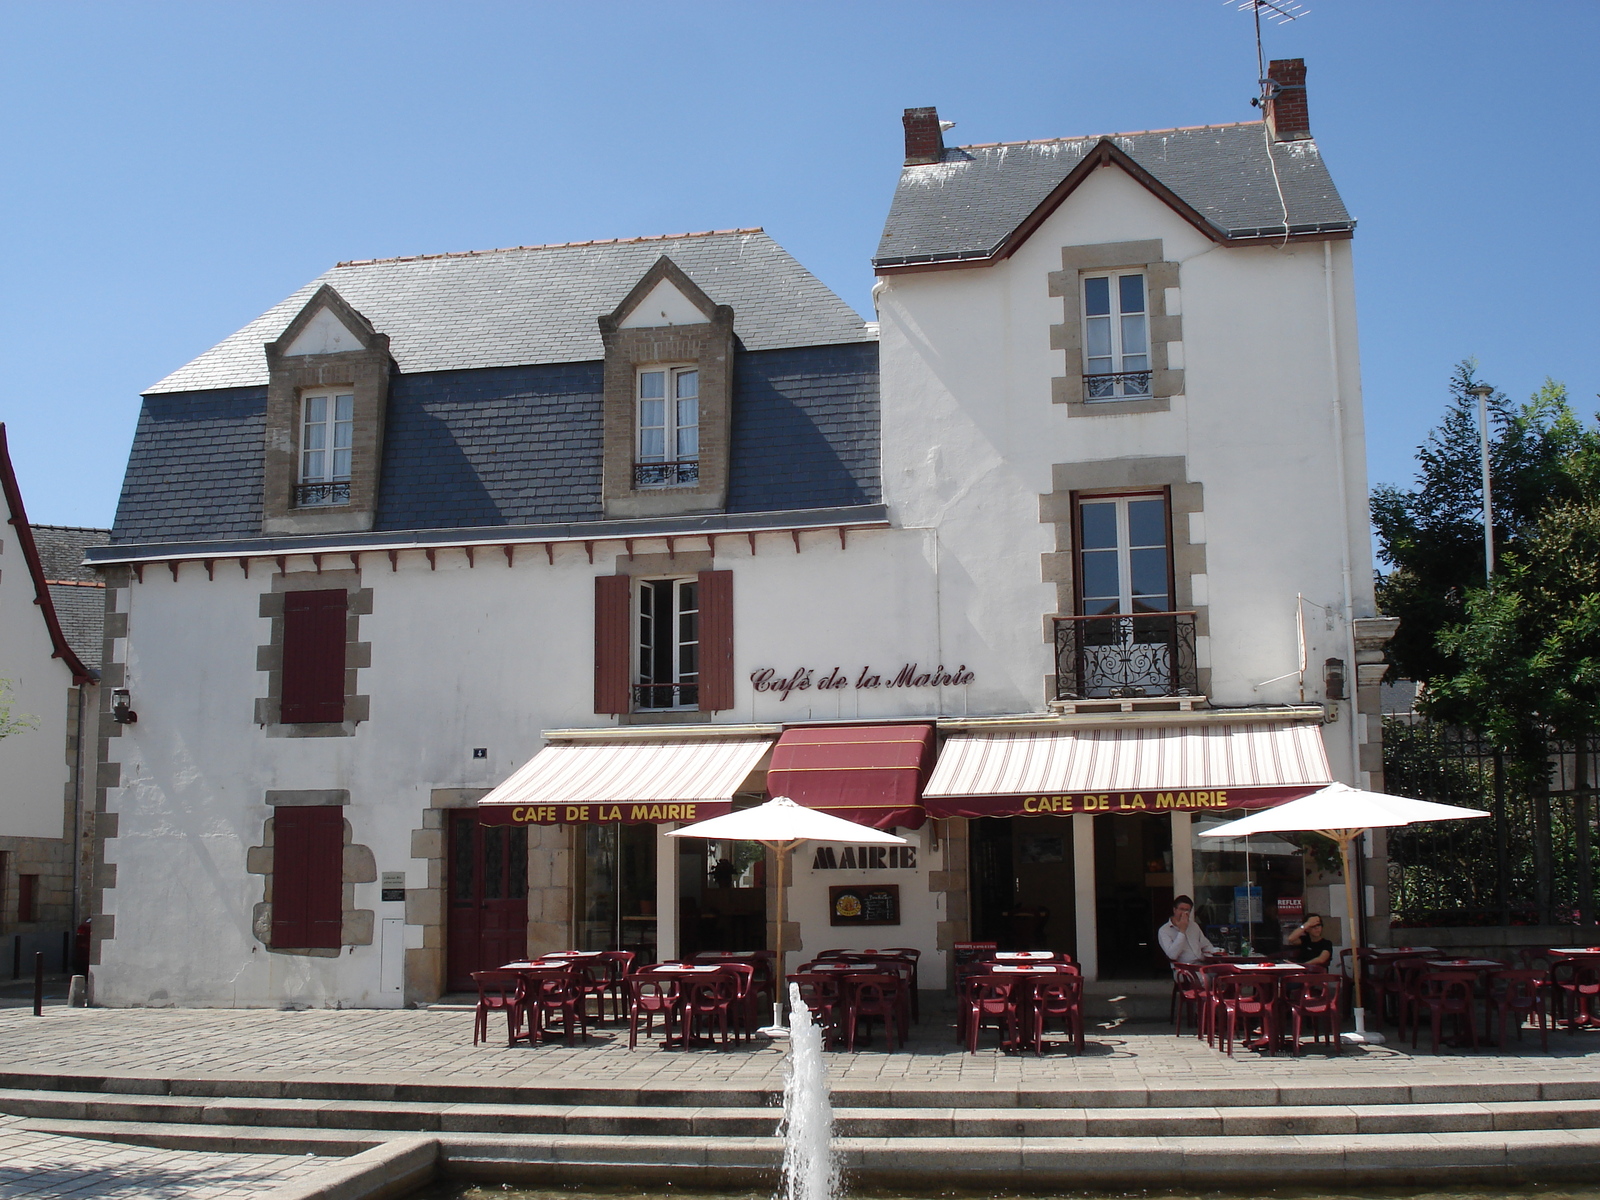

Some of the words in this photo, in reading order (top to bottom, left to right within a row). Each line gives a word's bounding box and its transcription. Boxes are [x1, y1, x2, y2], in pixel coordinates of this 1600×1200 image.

[750, 667, 814, 701] Café
[817, 666, 848, 690] de
[855, 666, 881, 689] la
[886, 663, 975, 688] Mairie
[512, 806, 556, 822] CAFE
[566, 806, 589, 821] DE
[599, 805, 622, 820] LA
[631, 804, 696, 820] MAIRIE
[1023, 796, 1073, 813] CAFE
[1083, 795, 1109, 810] DE
[1120, 793, 1146, 809] LA
[1156, 791, 1228, 808] MAIRIE
[812, 846, 917, 869] MAIRIE
